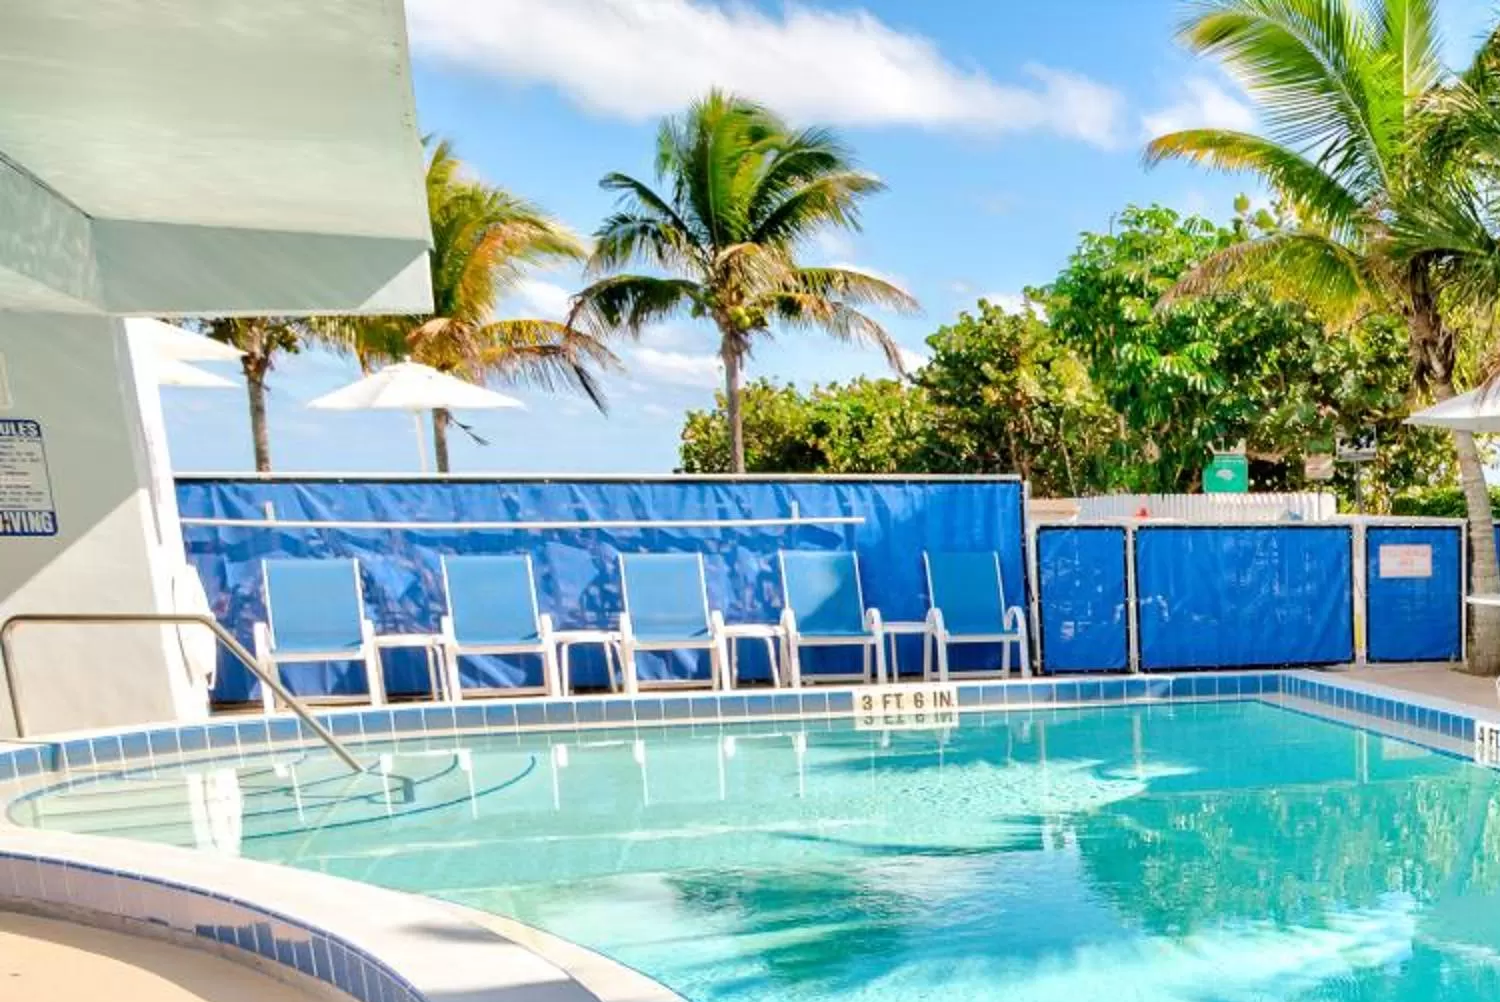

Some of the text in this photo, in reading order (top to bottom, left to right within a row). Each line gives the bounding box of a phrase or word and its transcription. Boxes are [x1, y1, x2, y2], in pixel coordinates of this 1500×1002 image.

[0, 511, 54, 533] IVING
[861, 694, 873, 711] 3
[913, 691, 925, 708] 6
[933, 690, 955, 708] IN.
[1478, 727, 1485, 744] 4
